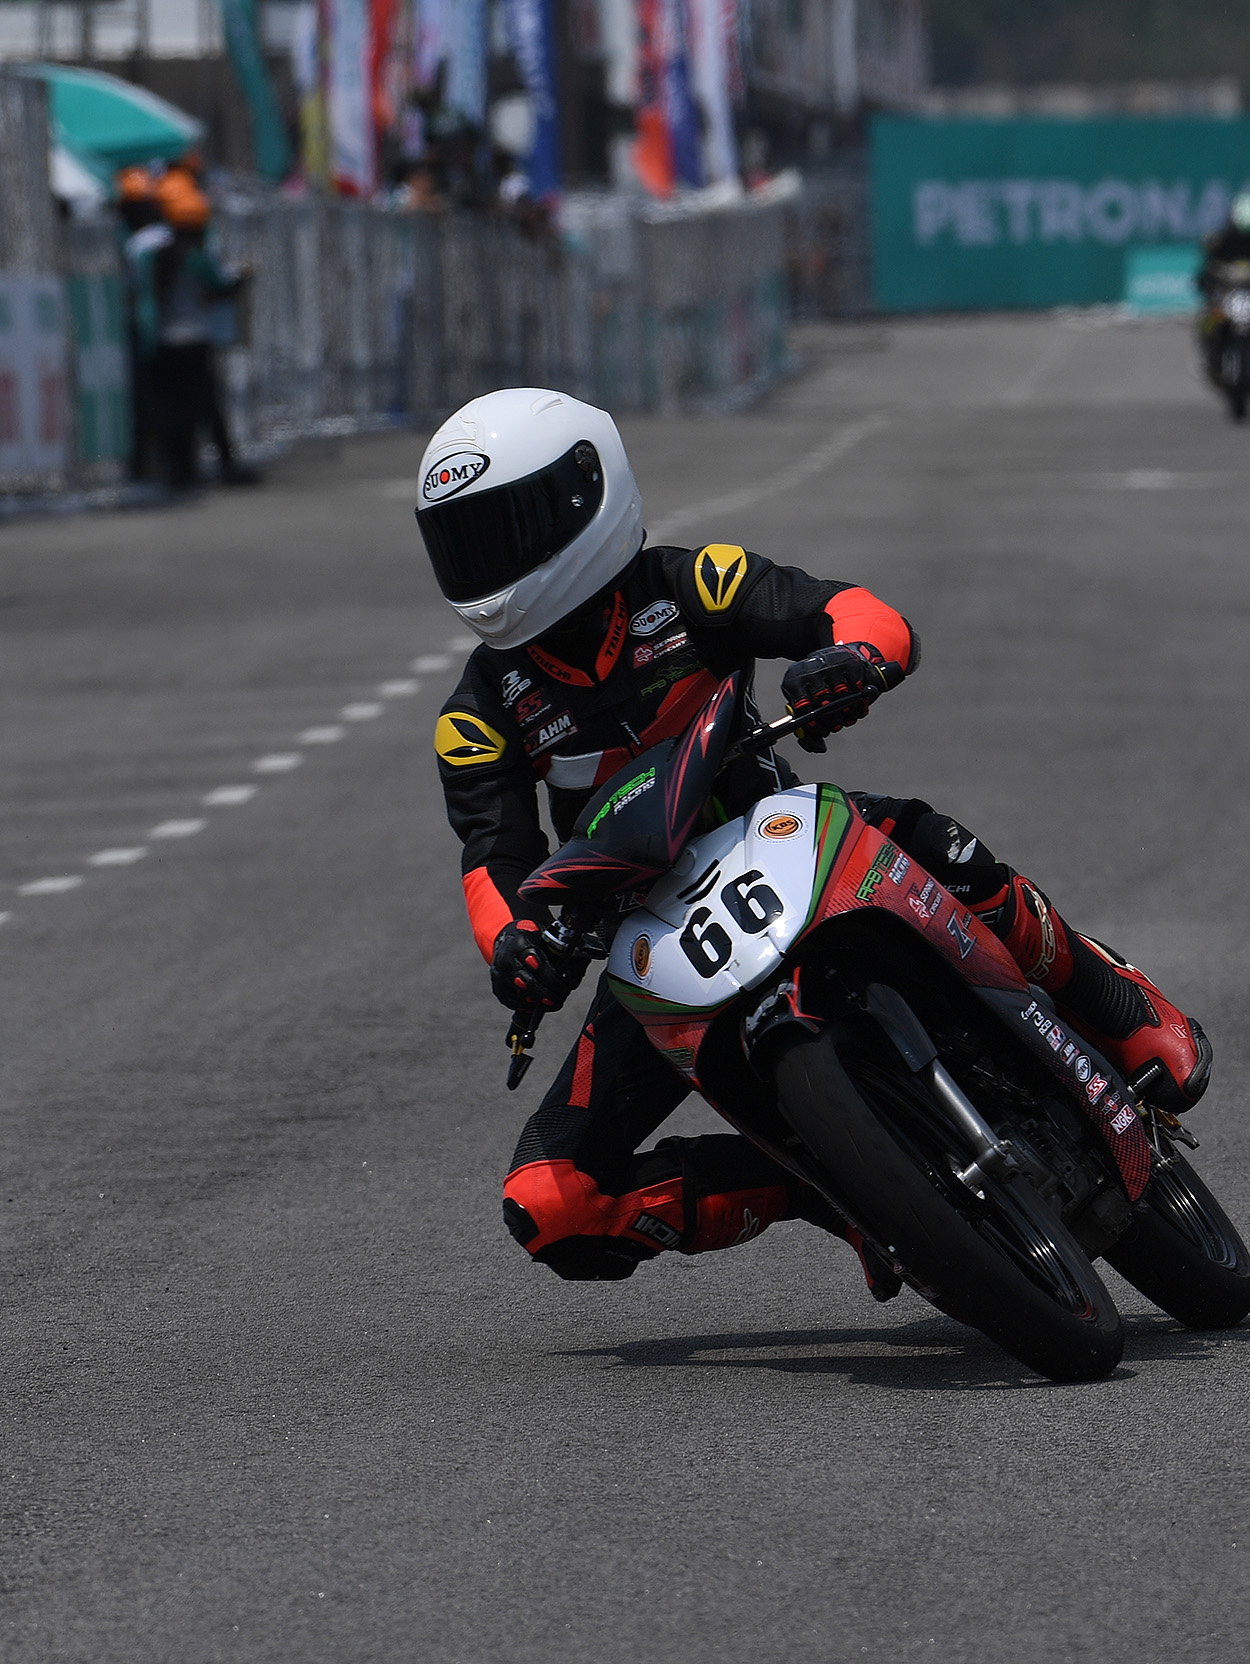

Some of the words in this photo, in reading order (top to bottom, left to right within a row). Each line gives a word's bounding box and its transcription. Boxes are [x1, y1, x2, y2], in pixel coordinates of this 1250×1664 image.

[425, 462, 482, 491] SUOMY
[605, 601, 625, 657] TAICHI
[539, 714, 571, 744] AHM
[680, 869, 784, 978] 66
[1112, 1106, 1135, 1133] NGK
